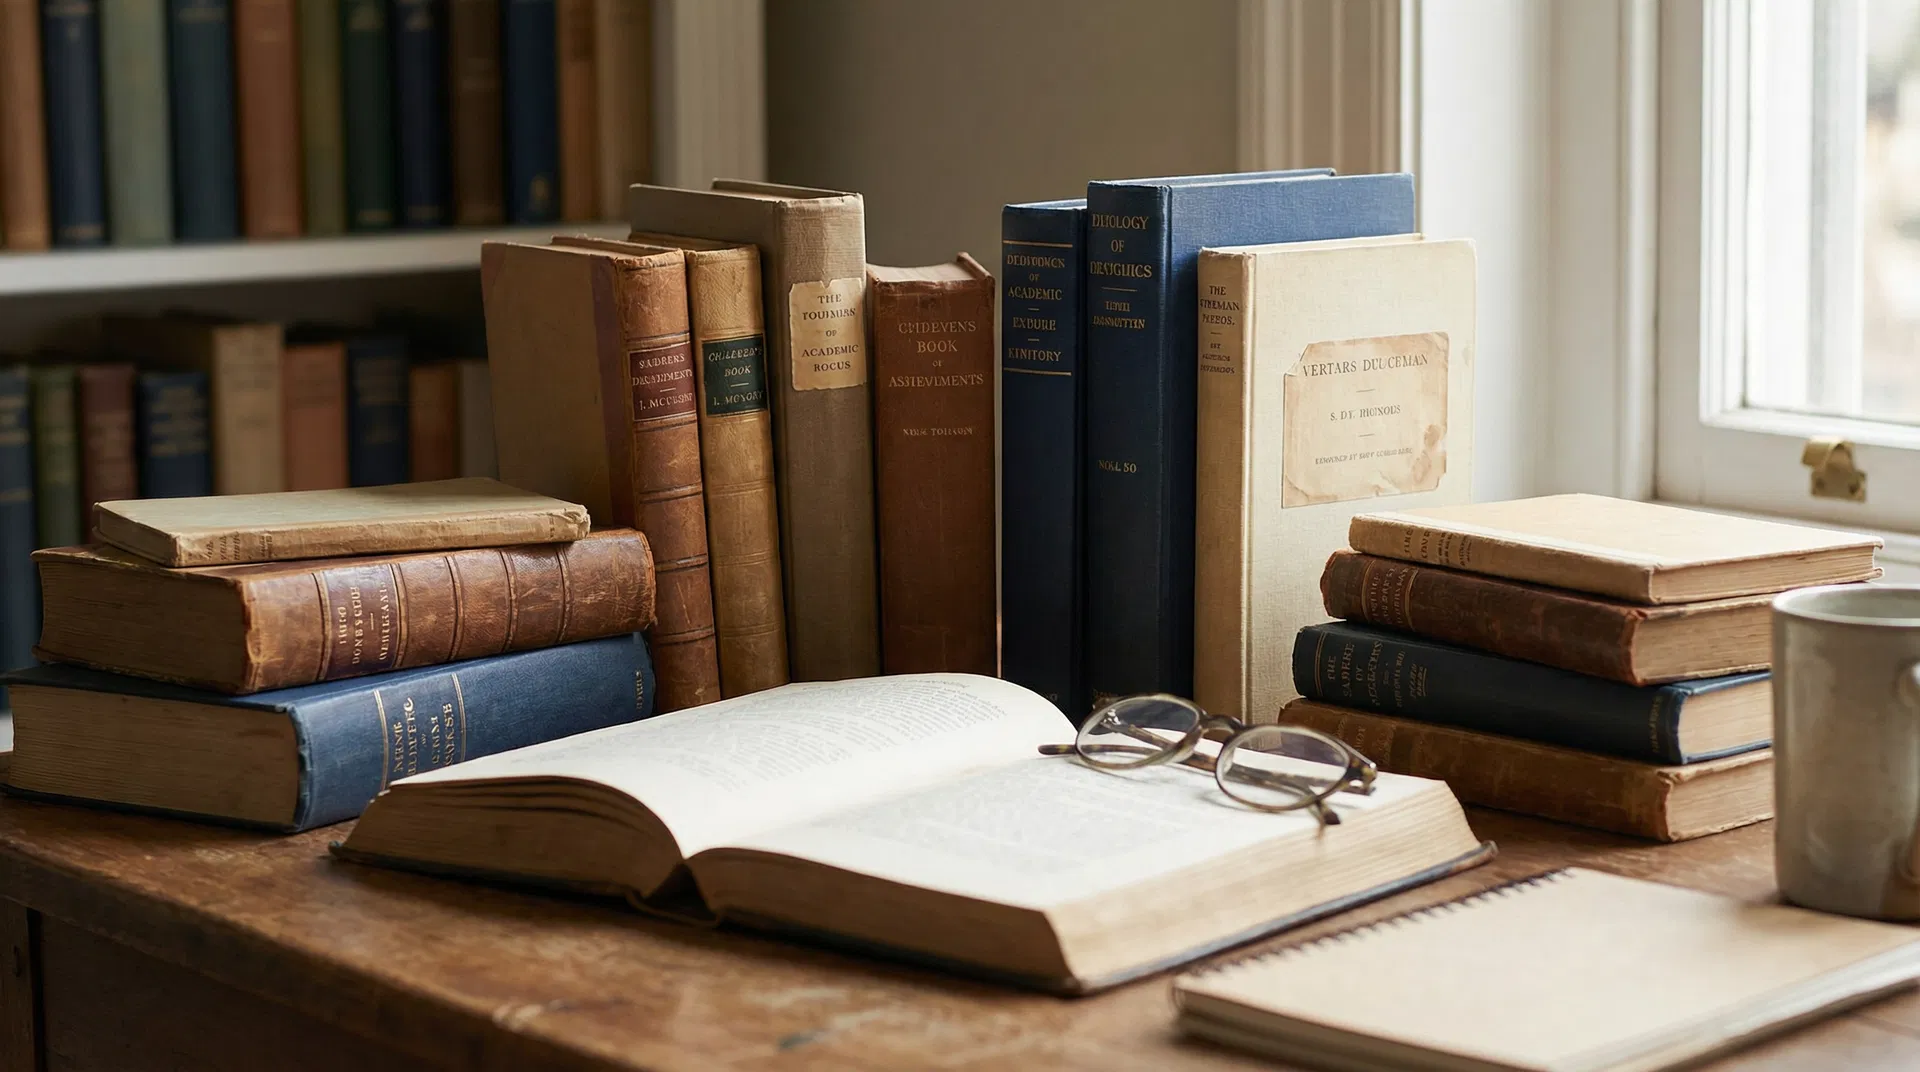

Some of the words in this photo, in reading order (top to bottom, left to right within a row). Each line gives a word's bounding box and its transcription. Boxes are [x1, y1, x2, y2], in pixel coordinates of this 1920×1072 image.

[1111, 240, 1125, 252] OF
[1008, 287, 1063, 300] ACADEMIC
[1209, 285, 1226, 296] THE
[817, 293, 842, 304] THE
[801, 345, 859, 358] ACADEMIC
[916, 340, 957, 353] BOOK
[724, 365, 751, 377] BOOK
[813, 361, 851, 373] ROCUS
[1302, 360, 1357, 377] VERTARS
